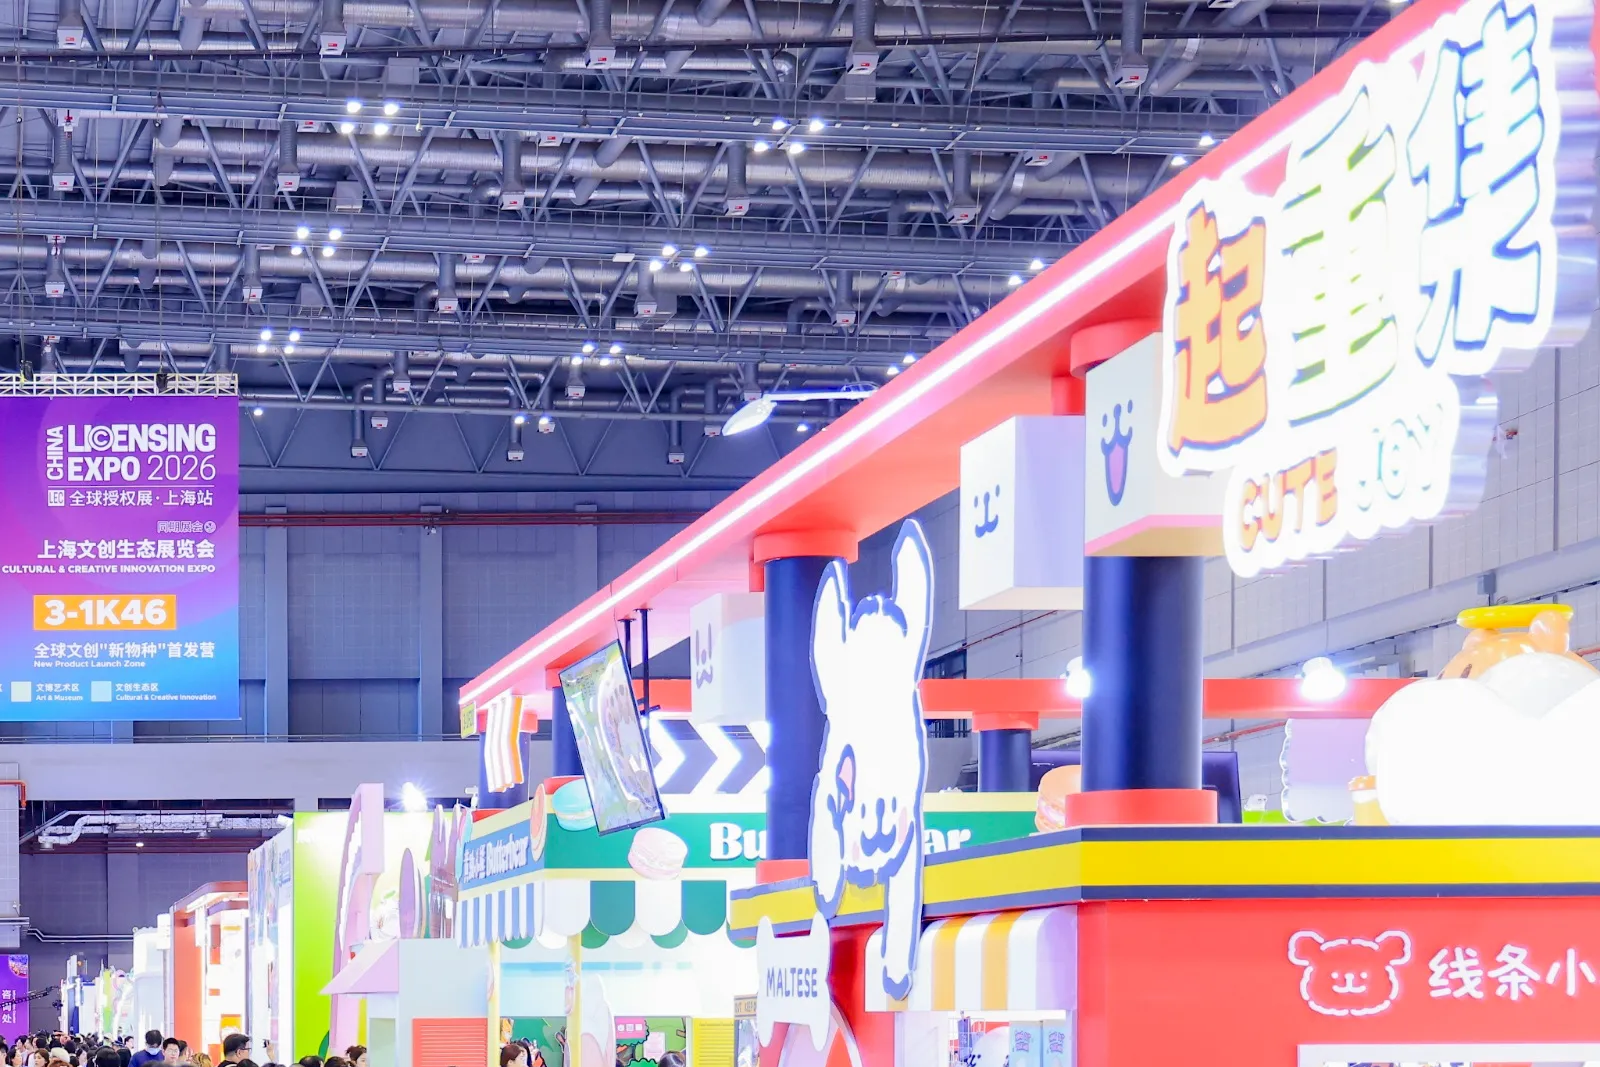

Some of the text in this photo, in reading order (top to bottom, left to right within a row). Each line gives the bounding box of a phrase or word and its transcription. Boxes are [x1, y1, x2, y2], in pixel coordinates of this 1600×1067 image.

[47, 426, 64, 480] CHINA
[68, 454, 216, 481] EXPO 2026
[1240, 403, 1446, 552] CUTE JOY
[37, 540, 215, 559] 上海文创生态展览会
[2, 565, 56, 574] CULTURAL
[59, 565, 65, 573] &
[68, 565, 118, 573] CREATIVE
[120, 565, 184, 573] INNOVATION
[187, 565, 215, 573] EXPO
[44, 599, 167, 626] 3-1K46
[55, 660, 88, 668] Product
[766, 966, 818, 998] MALTESE
